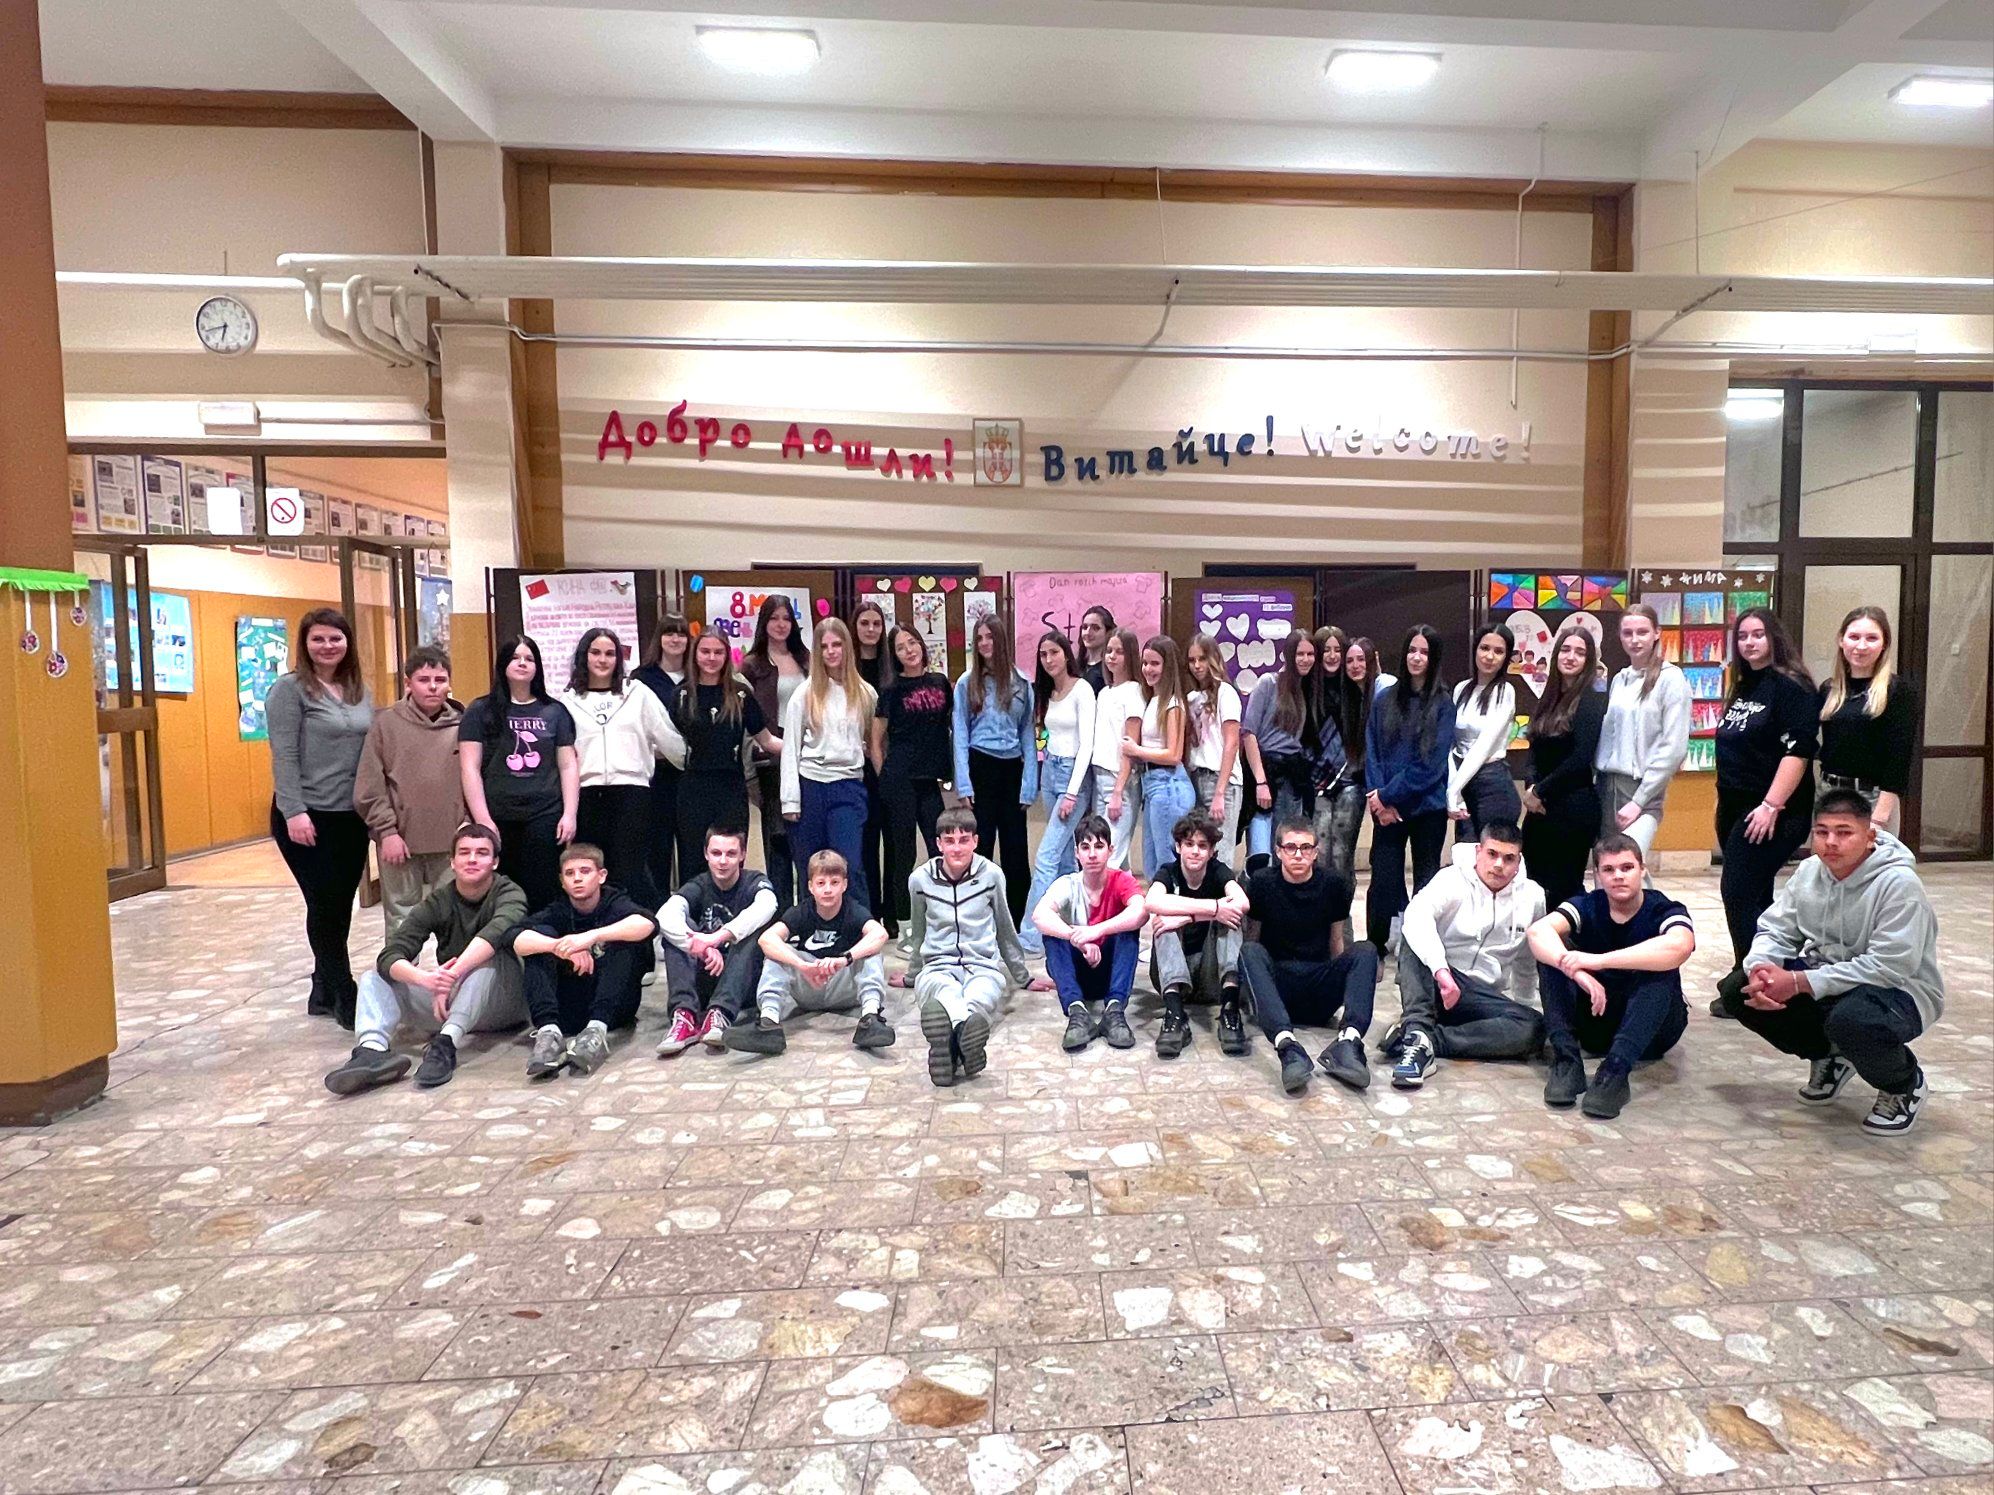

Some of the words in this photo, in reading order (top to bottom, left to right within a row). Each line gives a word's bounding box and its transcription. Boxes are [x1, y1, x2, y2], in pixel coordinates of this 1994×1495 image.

[598, 399, 752, 462] Добро
[1040, 415, 1275, 483] Витайце!
[1301, 415, 1533, 463] Welcome!
